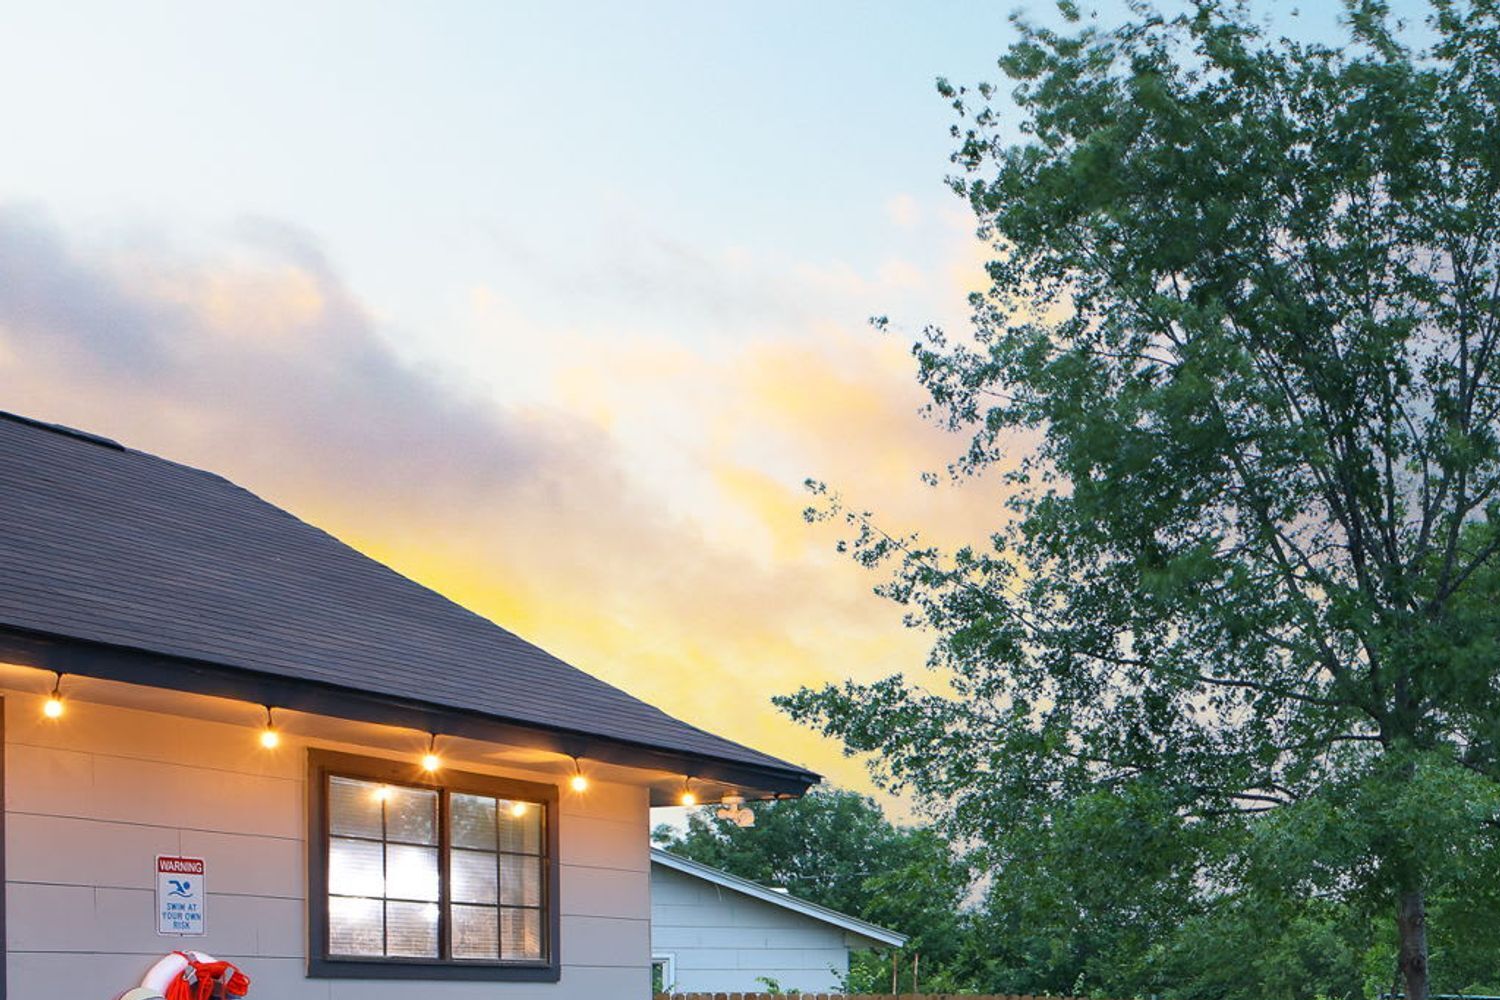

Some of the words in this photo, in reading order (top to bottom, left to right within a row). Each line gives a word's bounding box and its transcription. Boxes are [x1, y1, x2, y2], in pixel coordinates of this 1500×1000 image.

[159, 859, 202, 873] WARNING
[167, 903, 185, 911] SWIM
[188, 903, 197, 911] AT
[162, 912, 183, 920] YOUR
[185, 912, 201, 921] OWN
[173, 921, 190, 930] RISK
